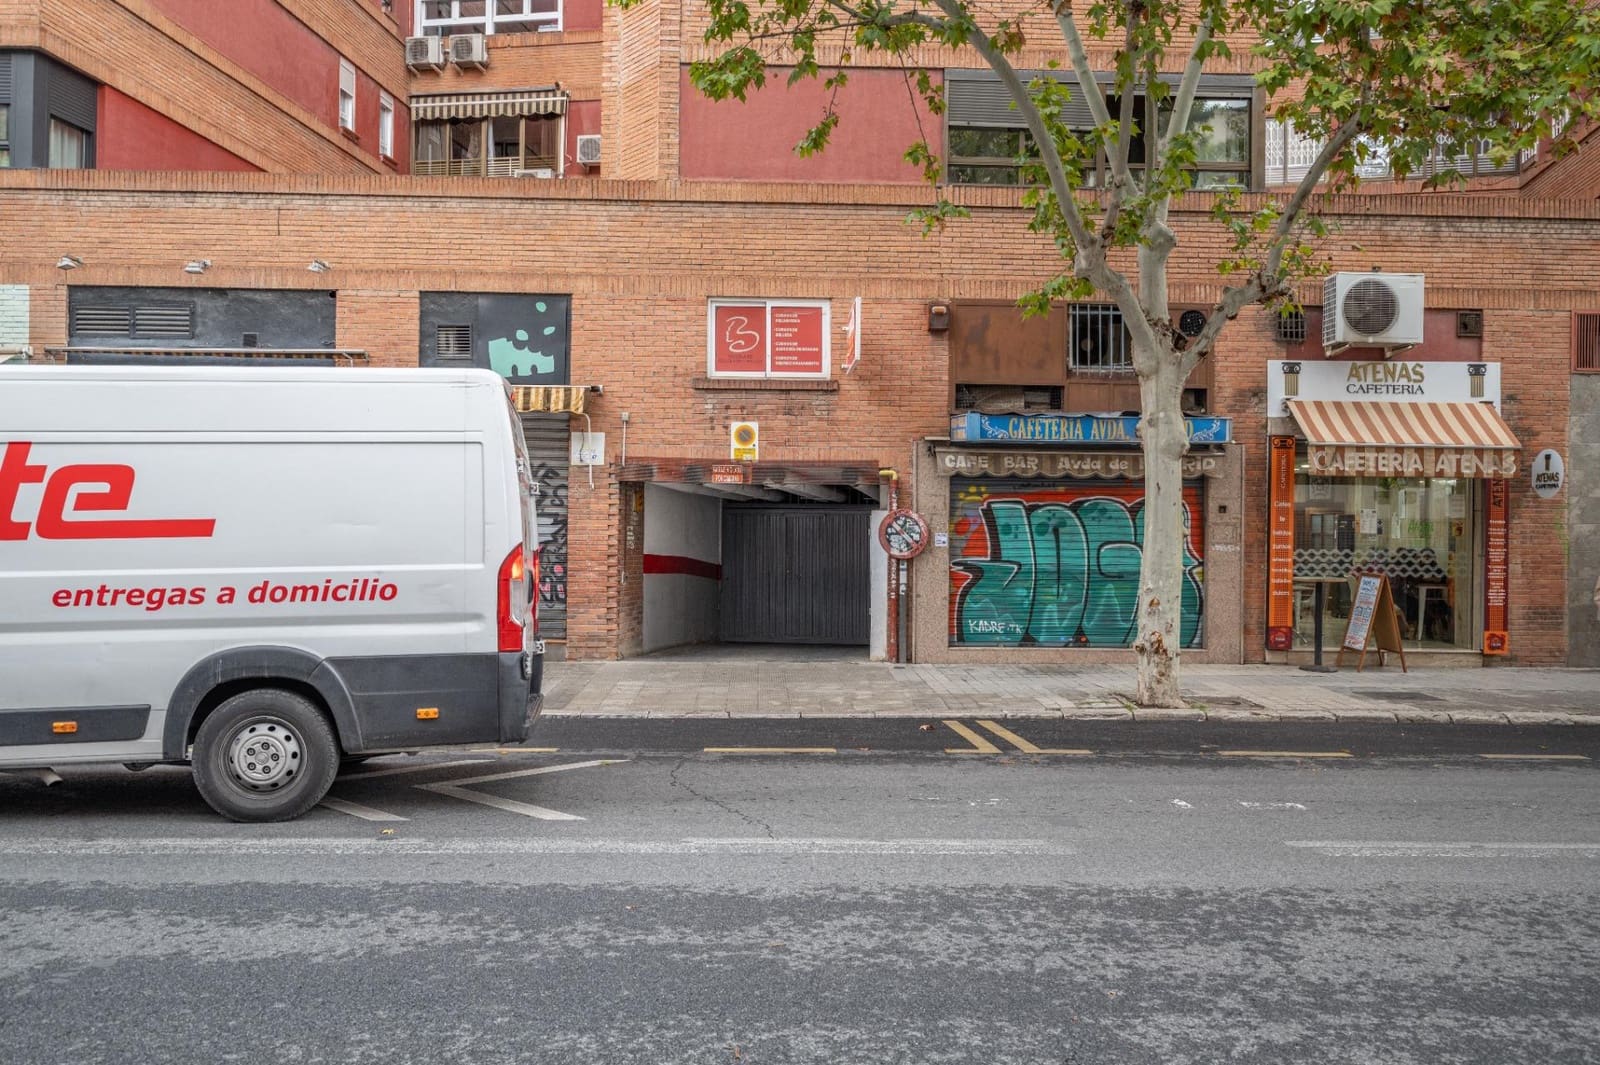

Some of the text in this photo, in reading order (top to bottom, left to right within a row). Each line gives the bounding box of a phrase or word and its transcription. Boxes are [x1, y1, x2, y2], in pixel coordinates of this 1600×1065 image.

[1346, 361, 1425, 384] ATENAS
[1346, 383, 1425, 395] CAFETERIA
[1003, 456, 1039, 471] BAR
[1057, 456, 1101, 470] Avda
[1109, 457, 1129, 470] de
[1313, 450, 1517, 474] CAFETERIA ATENAS
[1536, 472, 1560, 483] ATENAS
[52, 578, 398, 611] entregas a domicilio
